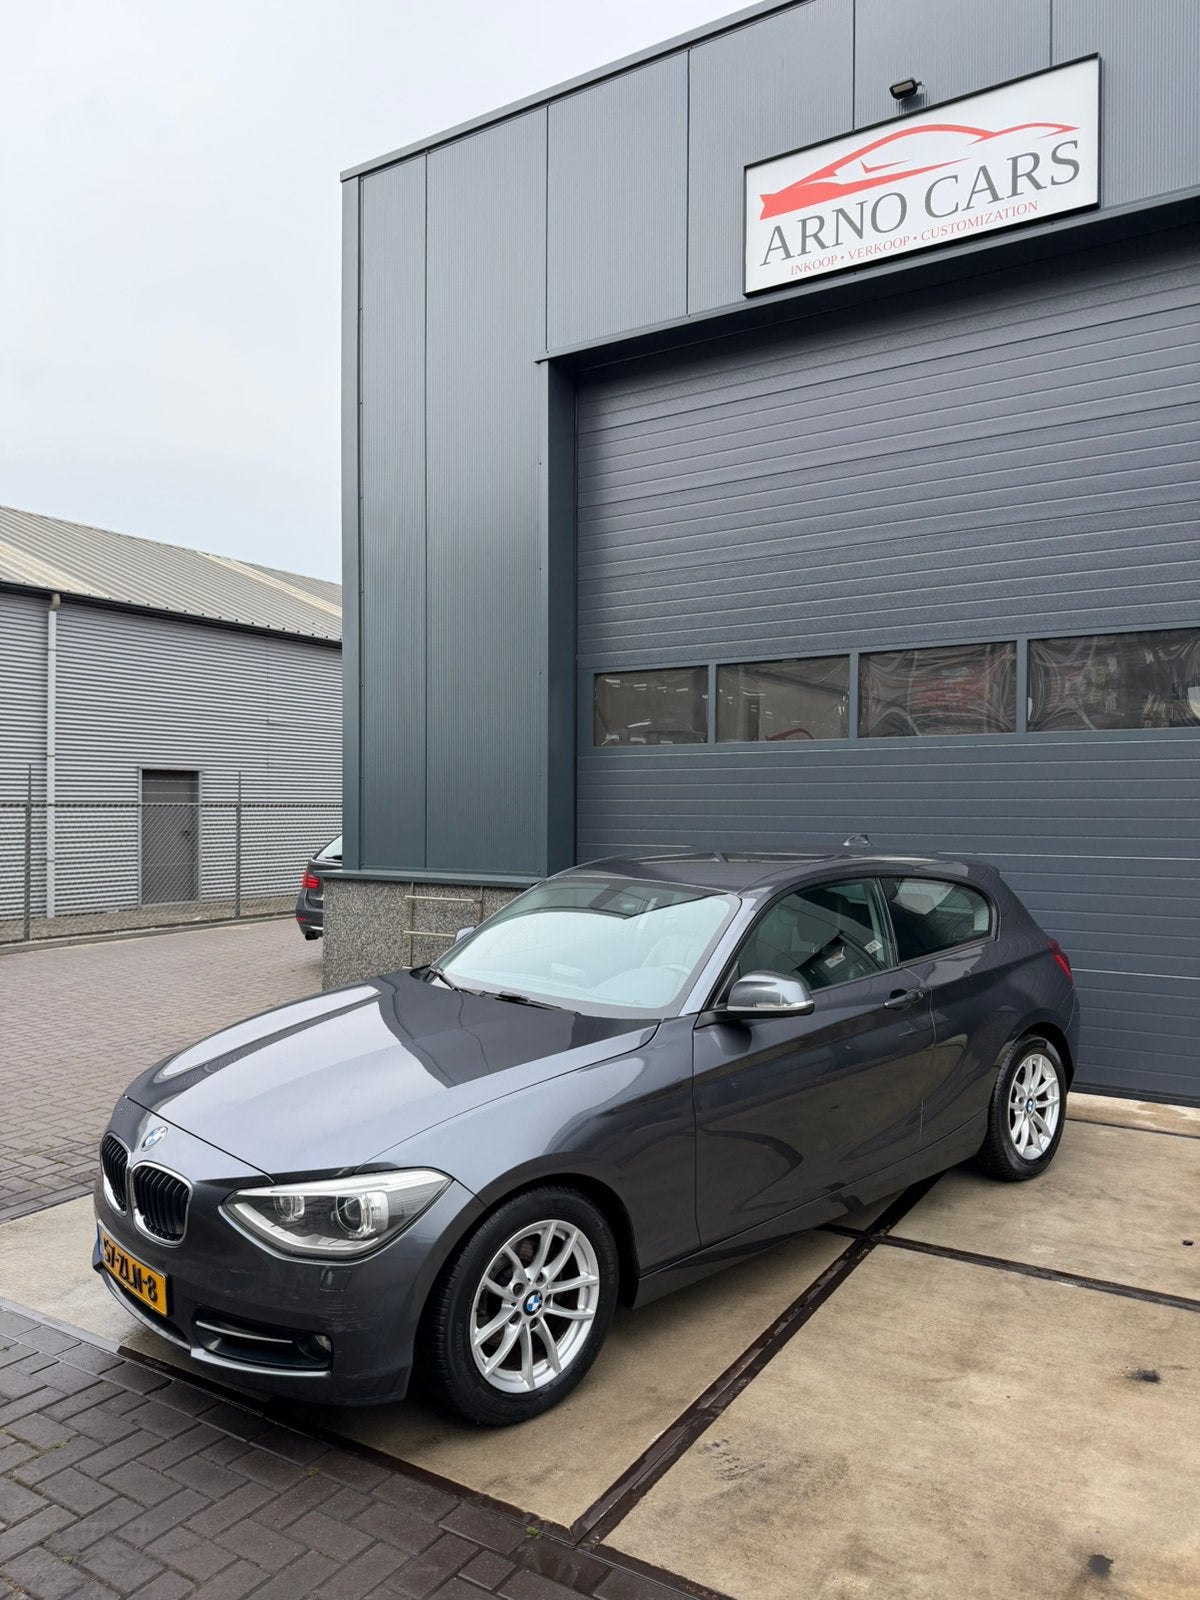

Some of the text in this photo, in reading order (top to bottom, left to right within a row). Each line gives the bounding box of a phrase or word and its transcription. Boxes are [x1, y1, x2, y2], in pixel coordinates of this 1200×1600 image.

[759, 139, 1080, 267] ARNO CARS
[790, 200, 1039, 276] INKOOP VERKOOP CUSTOMIZATION
